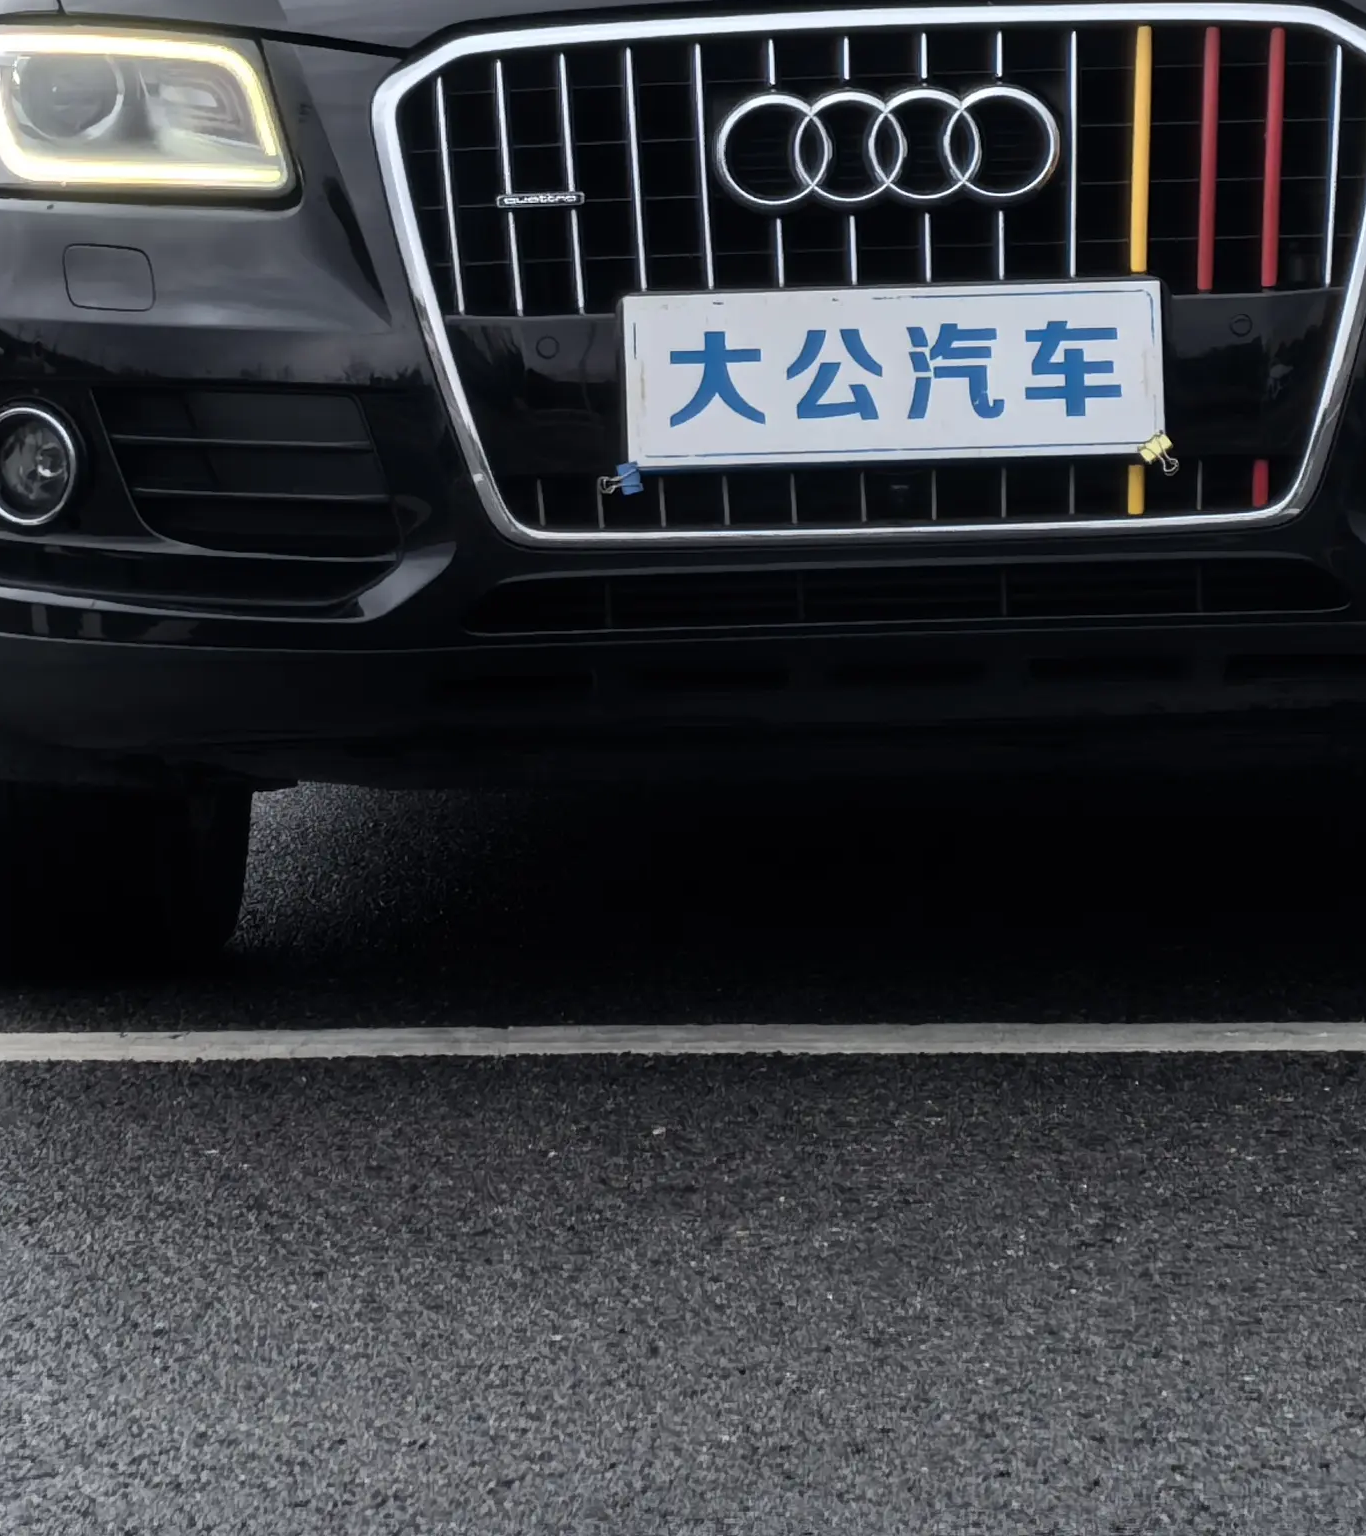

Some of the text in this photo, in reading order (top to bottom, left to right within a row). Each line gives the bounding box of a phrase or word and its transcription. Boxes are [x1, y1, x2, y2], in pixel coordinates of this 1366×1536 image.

[503, 193, 576, 205] quattro
[669, 320, 1122, 428] 大公汽车
